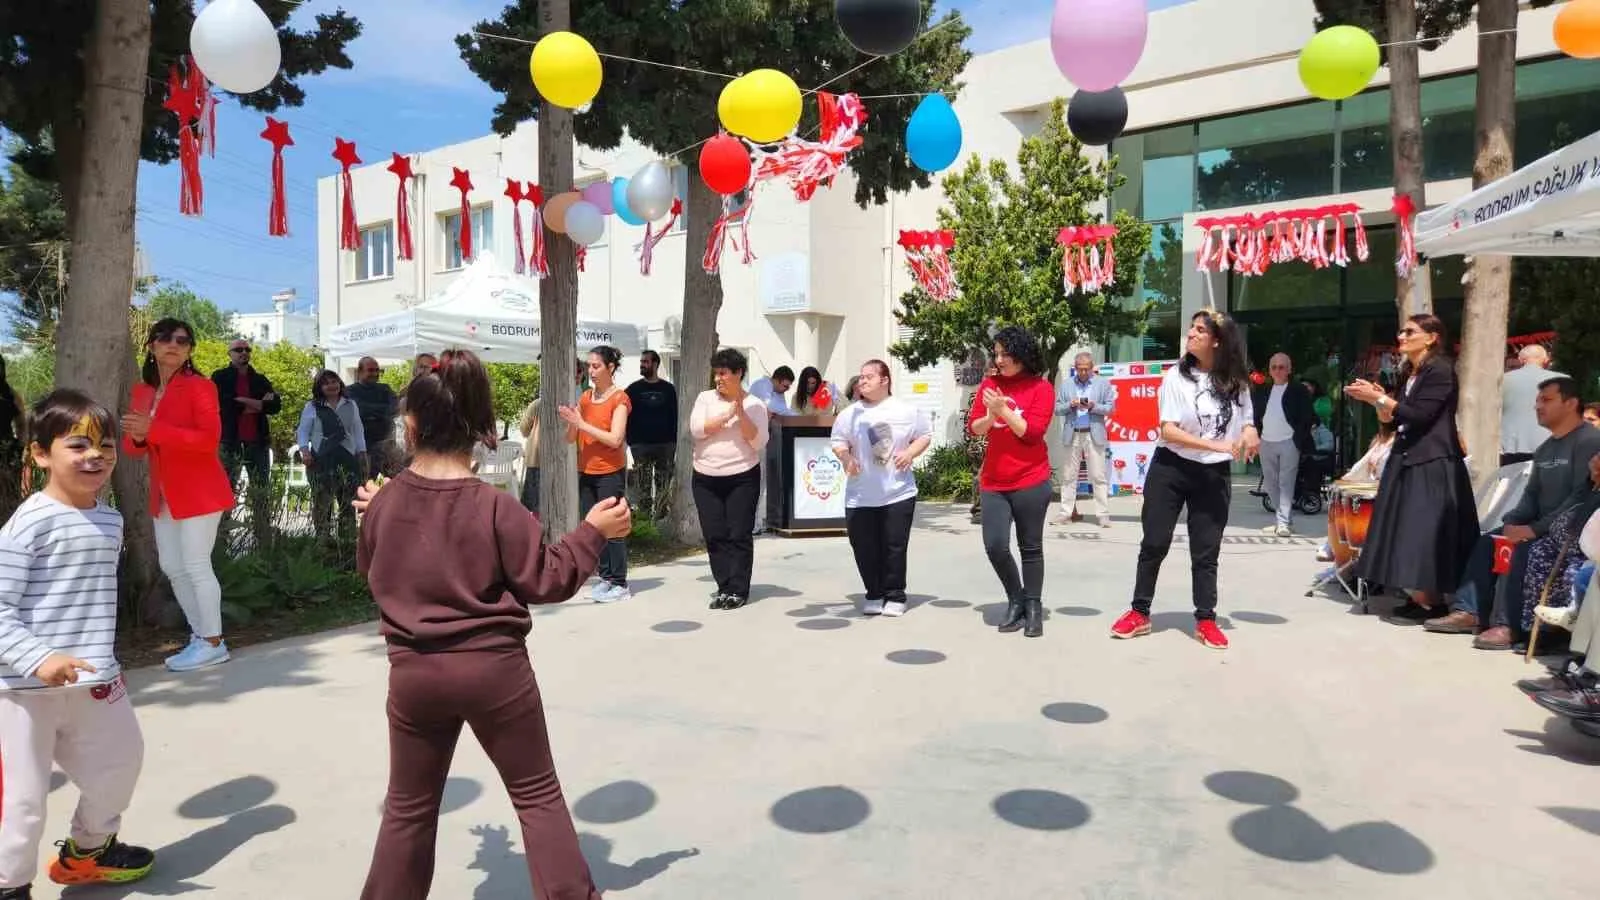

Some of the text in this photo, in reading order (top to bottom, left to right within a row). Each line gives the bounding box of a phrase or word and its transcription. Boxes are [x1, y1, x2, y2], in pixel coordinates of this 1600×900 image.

[1533, 160, 1588, 198] SAĞLIK
[491, 324, 540, 336] BODRUM
[583, 331, 612, 343] VAKFI
[1131, 384, 1160, 398] NİS
[1104, 414, 1139, 441] UTLU
